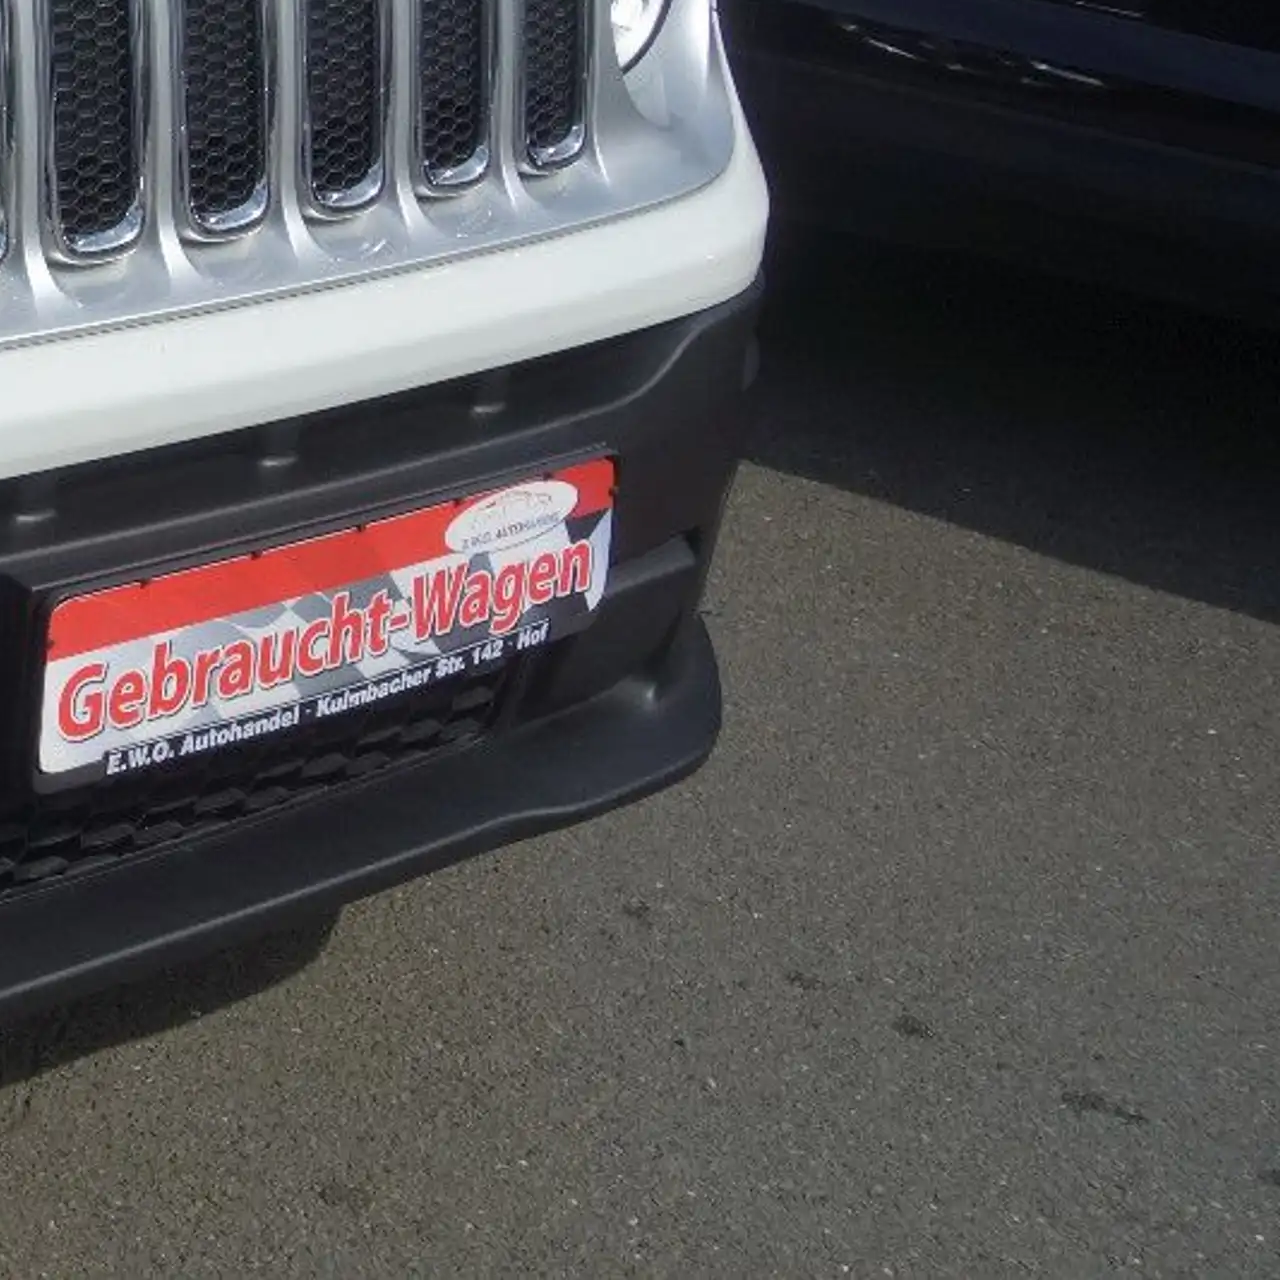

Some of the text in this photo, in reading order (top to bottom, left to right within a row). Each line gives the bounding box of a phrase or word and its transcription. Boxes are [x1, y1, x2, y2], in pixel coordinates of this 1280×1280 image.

[57, 540, 592, 742] Gebraucht-Wagen
[106, 743, 175, 775] E.W.O.
[180, 707, 300, 756] Autohandel
[316, 666, 431, 717] Kulmbacher
[472, 642, 503, 665] 142
[517, 619, 551, 650] Hof
